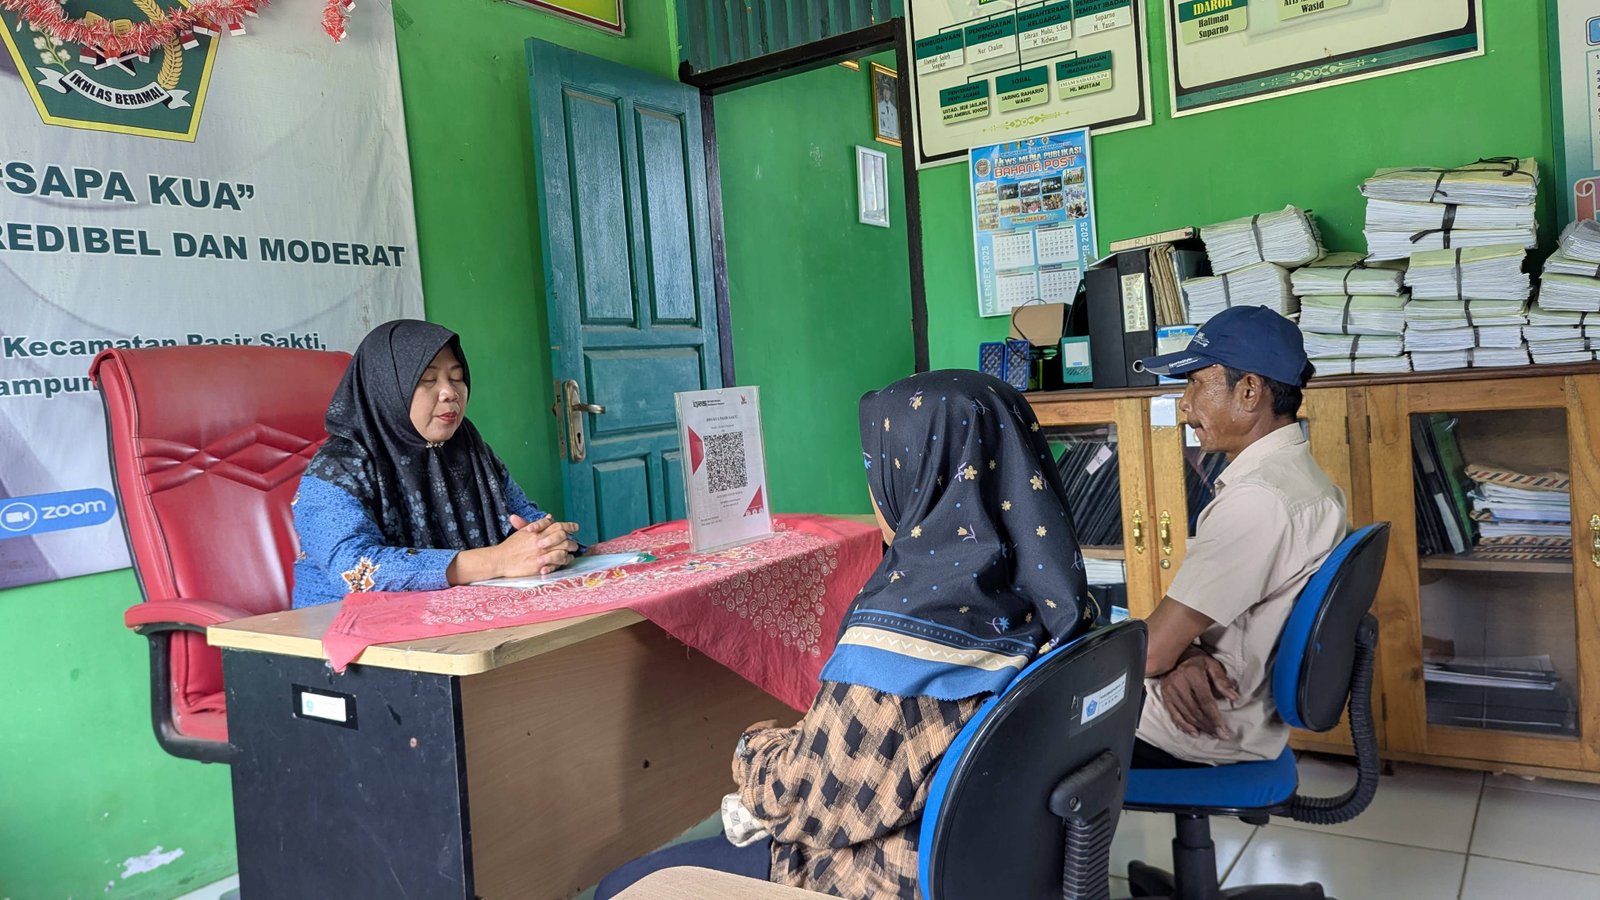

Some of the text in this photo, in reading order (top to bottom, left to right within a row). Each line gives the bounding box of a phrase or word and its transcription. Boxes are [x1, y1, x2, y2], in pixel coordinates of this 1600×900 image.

[1094, 12, 1116, 22] Suparno
[1301, 0, 1324, 14] Wasid
[1198, 25, 1229, 39] Suparno
[69, 72, 164, 106] IKHLAS BERAMAL
[1018, 153, 1042, 164] MEDIA
[1044, 146, 1082, 160] PUBLIKASI
[994, 161, 1042, 178] BAHANA
[1044, 156, 1076, 170] POST
[148, 174, 254, 211] KUA”
[1080, 221, 1089, 242] 2025
[174, 232, 248, 260] DAN
[260, 238, 406, 268] MODERAT
[981, 245, 993, 314] KALENDER 2025
[4, 332, 177, 358] Kecamatan
[260, 332, 326, 351] Sakti,
[41, 500, 106, 520] zoom
